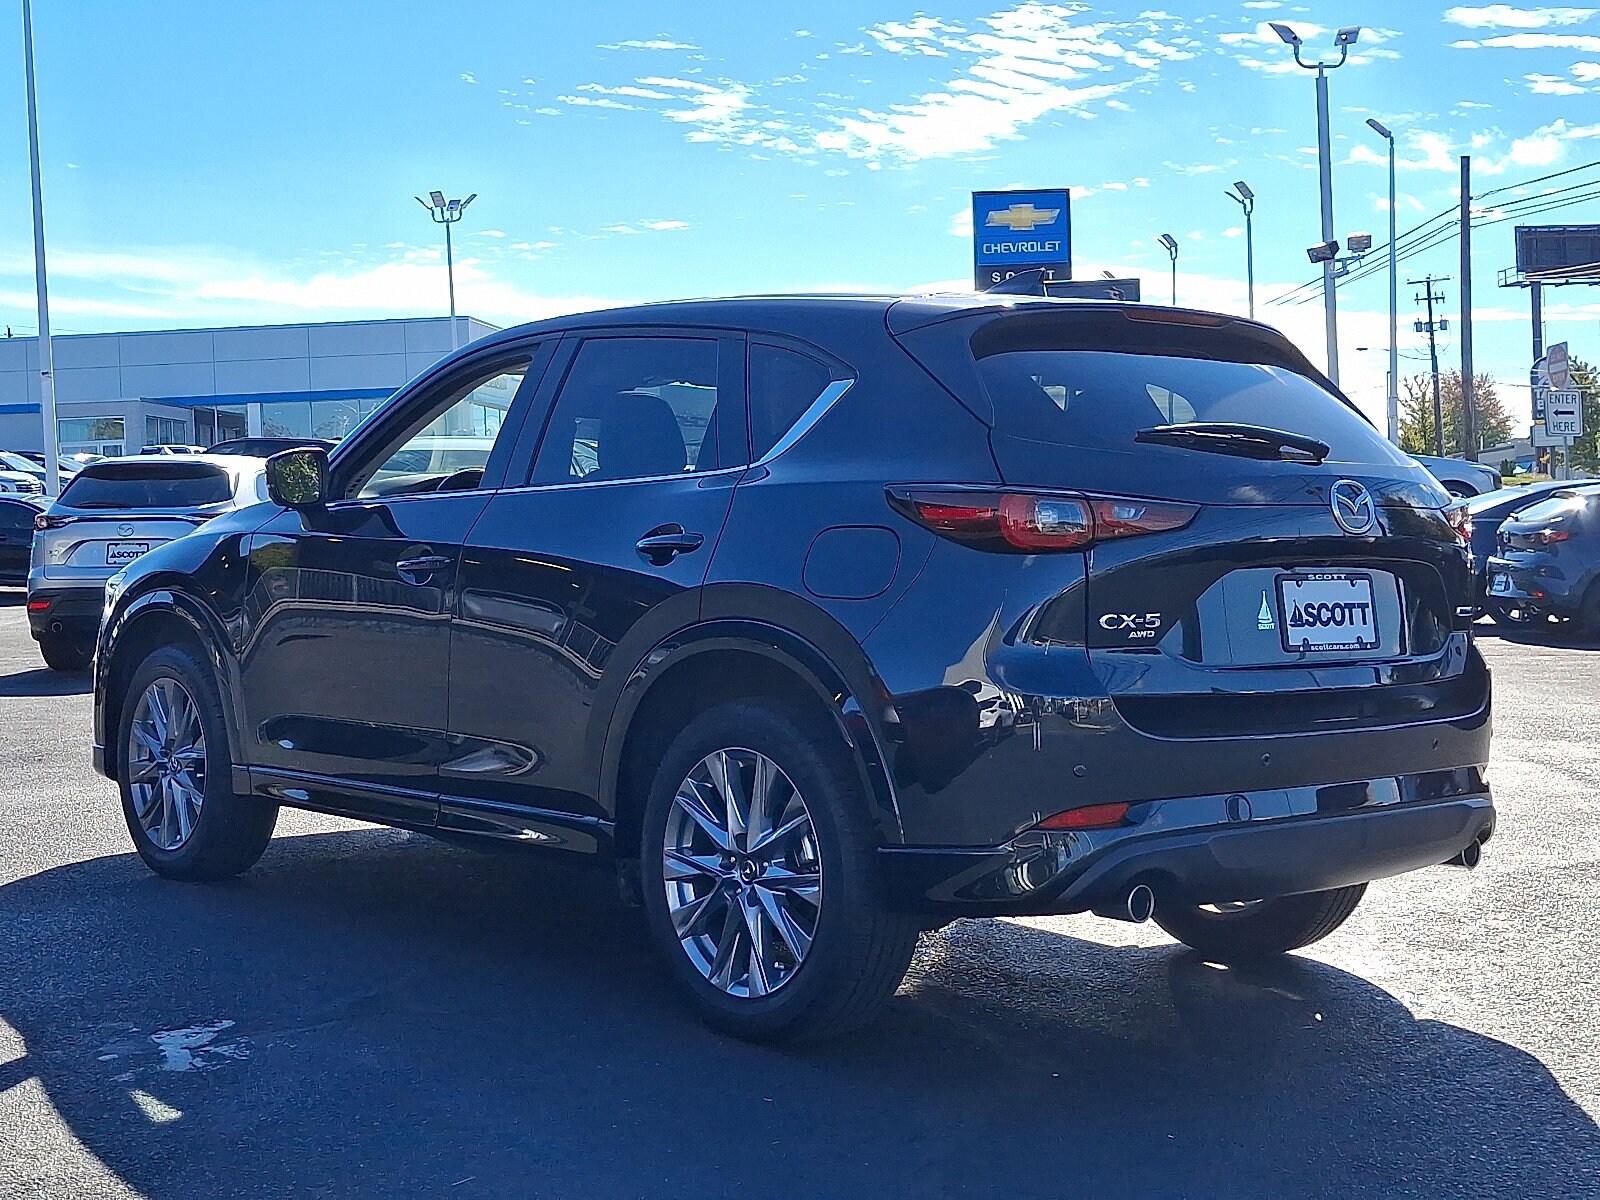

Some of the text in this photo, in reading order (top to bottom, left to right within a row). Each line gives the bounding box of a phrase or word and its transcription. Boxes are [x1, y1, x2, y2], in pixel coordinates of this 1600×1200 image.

[983, 241, 1061, 254] CHEVROLET
[1549, 394, 1577, 404] ENTER
[1553, 422, 1576, 432] HERE
[1304, 602, 1370, 627] SCOTT
[1099, 613, 1161, 629] CX-5
[1128, 630, 1155, 639] AWD
[1310, 643, 1361, 651] scottcars.com
